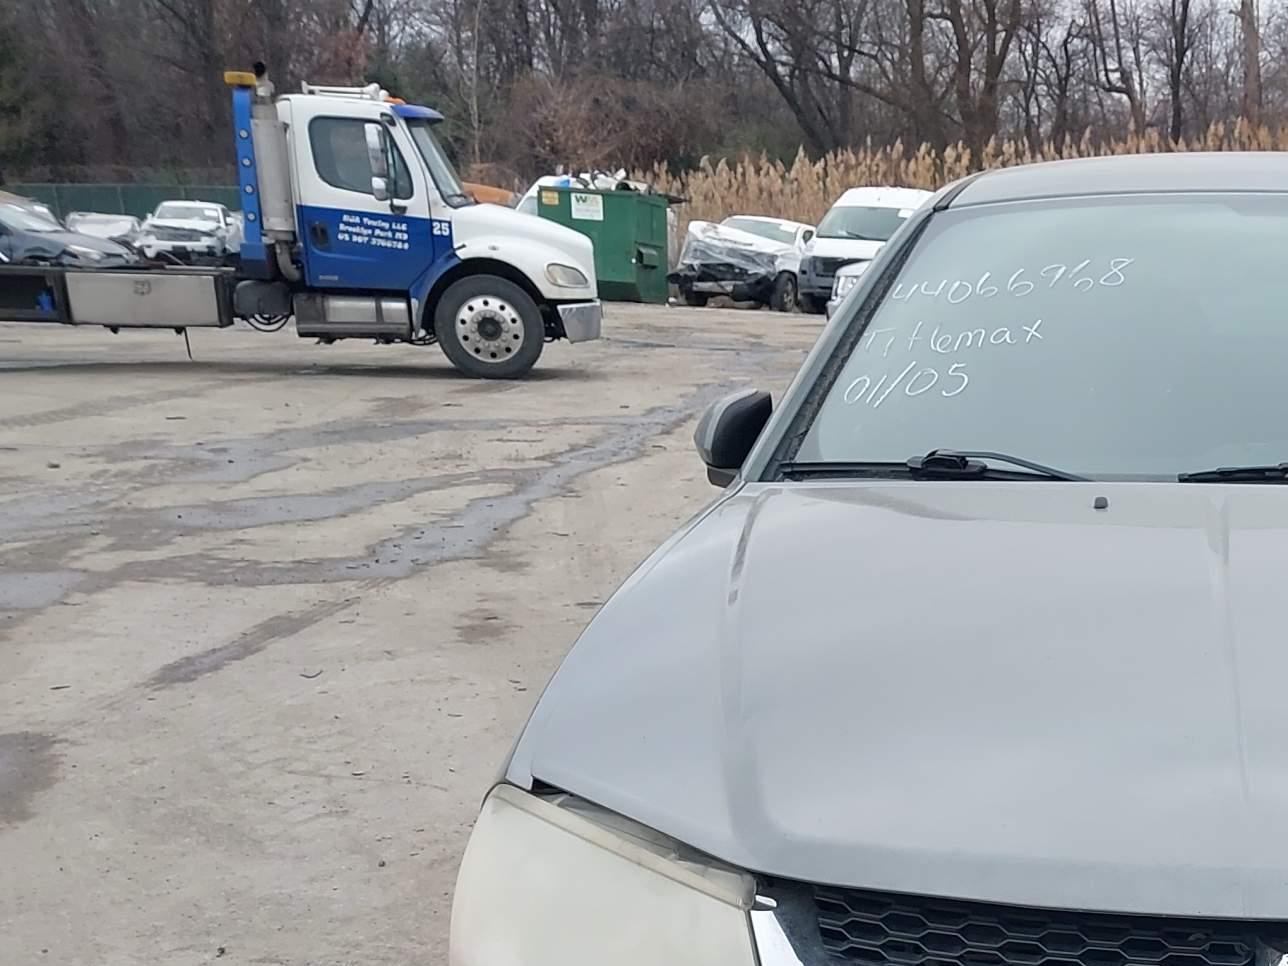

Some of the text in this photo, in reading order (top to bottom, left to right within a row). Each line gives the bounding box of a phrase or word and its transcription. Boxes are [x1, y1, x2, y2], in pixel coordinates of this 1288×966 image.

[391, 221, 408, 231] LLC
[432, 221, 450, 236] 25
[337, 232, 350, 241] US
[351, 234, 369, 244] DOT
[374, 228, 393, 238] Park
[892, 258, 1135, 303] 44066968
[843, 361, 970, 409] 01/05
